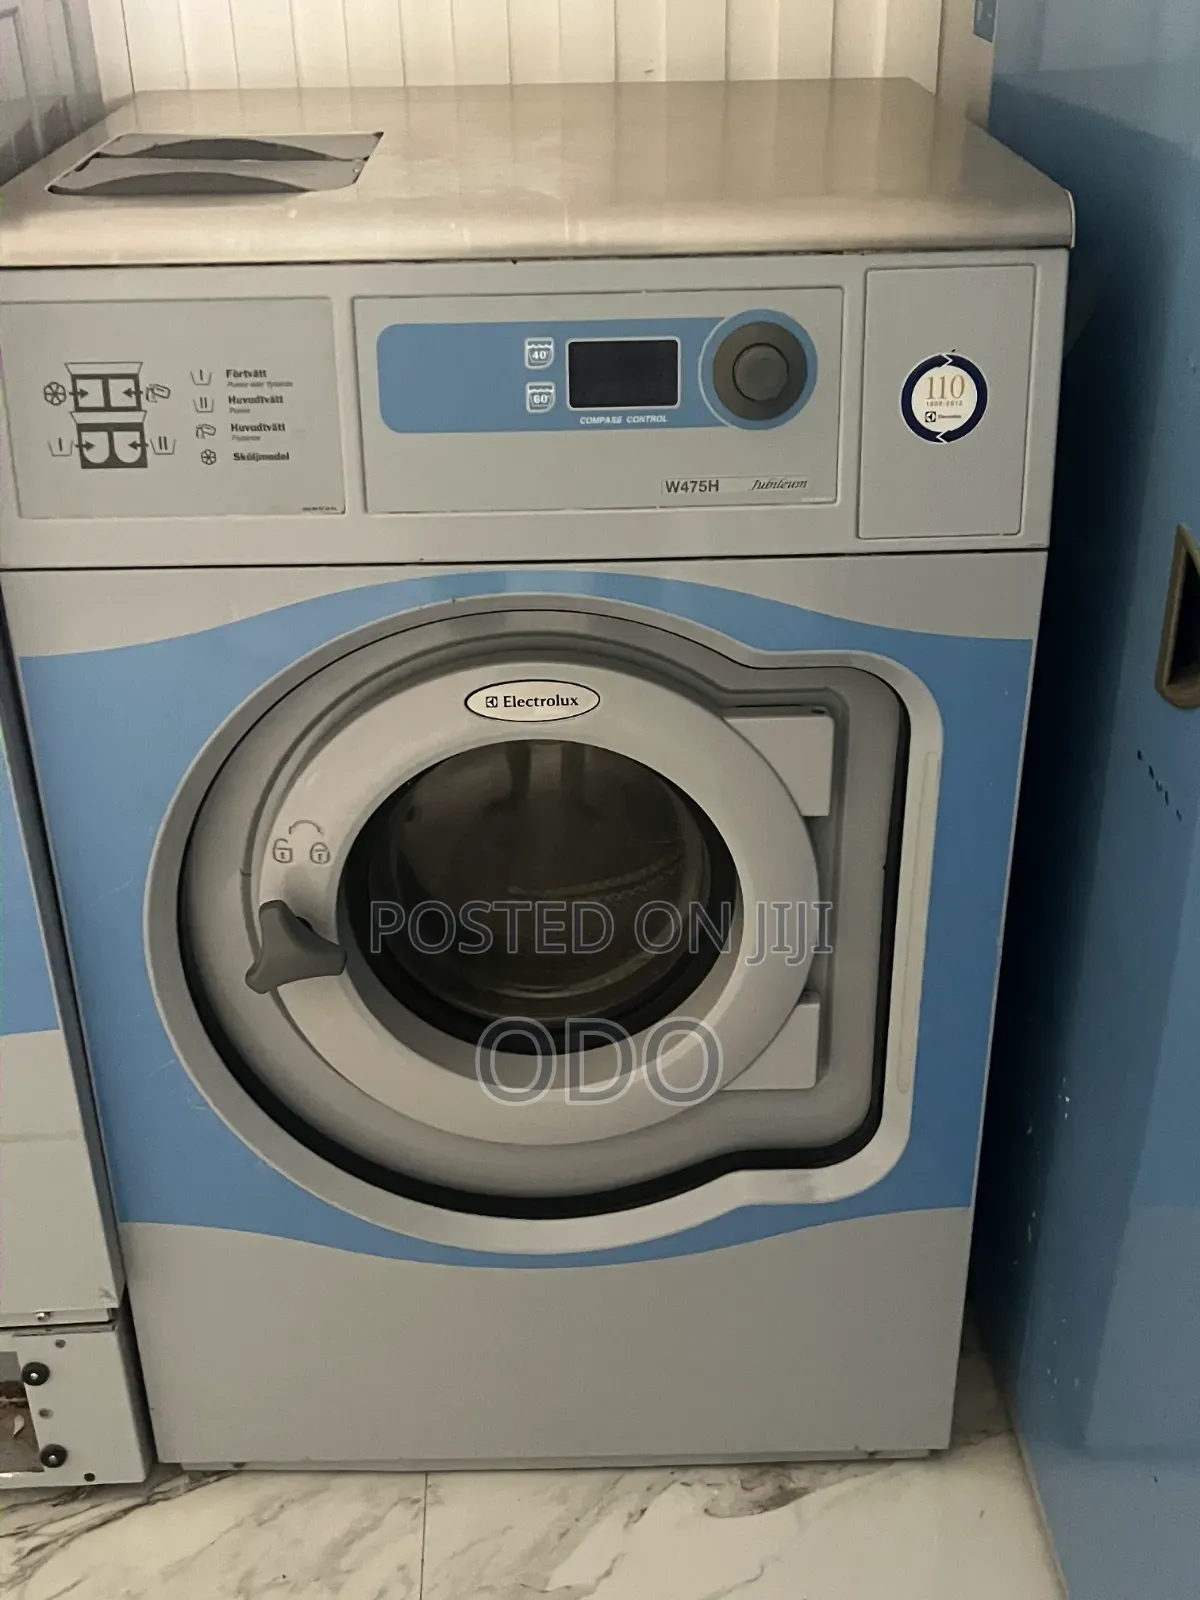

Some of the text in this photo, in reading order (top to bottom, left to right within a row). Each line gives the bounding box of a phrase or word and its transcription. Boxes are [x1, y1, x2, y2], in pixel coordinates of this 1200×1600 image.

[926, 374, 966, 400] 110
[579, 414, 669, 425] COMPASS CONTROL
[665, 478, 808, 493] W475H Jubileum
[503, 694, 579, 708] Electrolux
